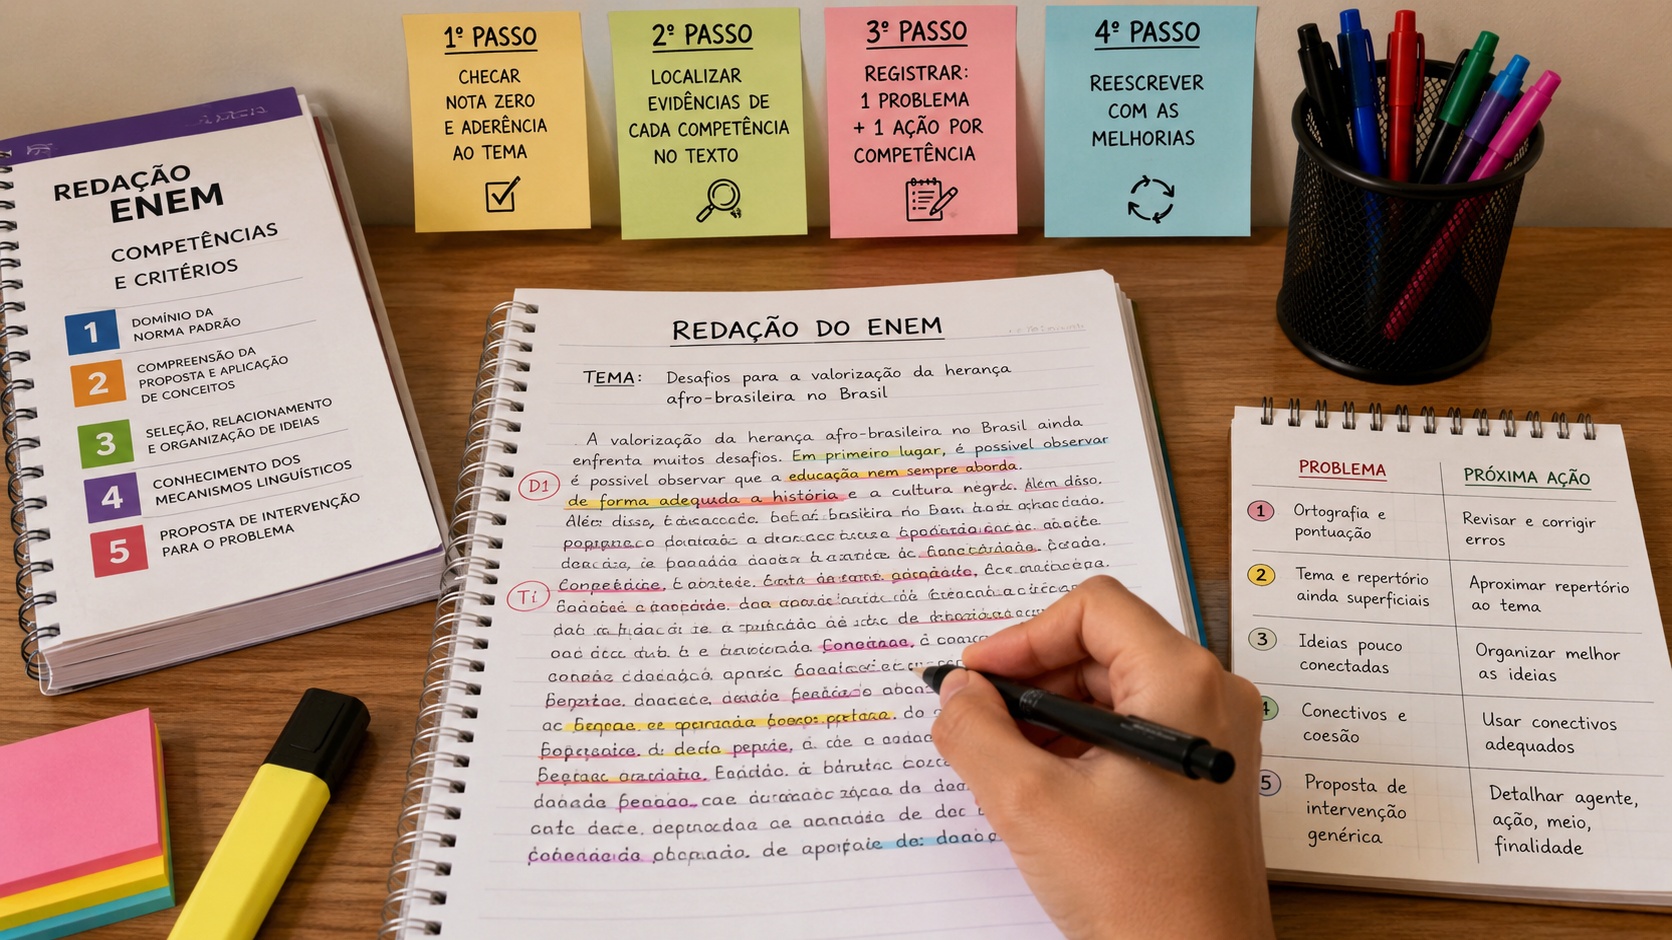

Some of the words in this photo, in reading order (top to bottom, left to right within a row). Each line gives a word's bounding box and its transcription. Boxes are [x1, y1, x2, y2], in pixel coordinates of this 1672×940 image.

[473, 26, 536, 47] PASSO
[685, 24, 752, 45] PASSO
[899, 20, 967, 42] PASSO
[1130, 20, 1200, 43] PASSO
[459, 69, 520, 84] CHECAR
[652, 68, 742, 85] LOCALIZAR
[865, 65, 968, 82] REGISTRAR:
[1090, 74, 1204, 91] REESCREVER
[447, 95, 487, 109] NOTA
[494, 94, 535, 108] ZERO
[649, 91, 740, 111] EVIDÊNCIAS
[749, 94, 769, 109] DE
[861, 92, 870, 109] 1
[879, 92, 969, 109] PROBLEMA
[1109, 103, 1147, 119] COM
[1157, 103, 1178, 118] AS
[445, 121, 453, 135] E
[462, 115, 547, 134] ADERÊNCIA
[629, 123, 670, 138] CADA
[678, 116, 789, 137] COMPETÊNCIA
[875, 119, 883, 135] 1
[893, 115, 939, 139] AÇÃO
[950, 118, 983, 134] POR
[1092, 130, 1195, 146] MELHORIAS
[453, 146, 474, 160] AO
[482, 144, 527, 159] TEMA
[655, 149, 677, 164] NO
[685, 148, 738, 163] TEXTO
[854, 142, 976, 163] COMPETÊNCIA
[54, 164, 190, 201] REDAÇÃO
[110, 183, 224, 224] ENEM
[111, 223, 278, 262] COMPETÊNCIAS
[115, 276, 126, 289] E
[135, 259, 238, 286] CRITÉRIOS
[132, 311, 191, 327] DOMÍNIO
[196, 308, 213, 318] DA
[85, 322, 97, 342] 1
[134, 327, 184, 342] NORMA
[189, 316, 240, 334] PADRÃO
[672, 315, 799, 343] REDAÇÃO
[816, 320, 850, 337] DO
[868, 317, 942, 336] ENEM
[137, 350, 235, 374] COMPREENSÃO
[237, 344, 257, 358] DA
[139, 371, 206, 389] PROPOSTA
[208, 367, 217, 379] E
[221, 355, 288, 375] APLICAÇÃO
[583, 370, 641, 387] TEMA:
[667, 370, 730, 387] Desafios
[743, 374, 778, 387] para
[812, 367, 901, 381] valorização
[914, 365, 934, 377] da
[945, 364, 1011, 377] herança
[89, 372, 108, 395] 2
[141, 393, 158, 403] DE
[162, 380, 236, 400] CONCEITOS
[667, 390, 795, 409] afro-brasileira
[807, 390, 828, 402] no
[840, 386, 887, 400] Brasil
[146, 420, 209, 440] SELEÇÃO,
[213, 398, 332, 428] RELACIONAMENTO
[148, 444, 156, 454] E
[160, 427, 255, 452] ORGANIZAÇÃO
[259, 424, 276, 435] DE
[280, 416, 319, 431] IDEIAS
[587, 432, 597, 445] A
[611, 433, 701, 448] valorização
[715, 432, 736, 444] da
[749, 431, 814, 444] herança
[826, 426, 942, 444] afro-brasileira
[953, 425, 971, 436] no
[981, 419, 1027, 433] Brasil
[1038, 416, 1083, 429] ainda
[97, 433, 115, 455] 3
[573, 453, 642, 470] enfrenta
[653, 454, 704, 466] muitos
[715, 450, 782, 467] desafios.
[793, 448, 816, 462] Em
[826, 448, 890, 463] primeiro
[900, 446, 946, 460] lugar,
[956, 442, 966, 454] é
[1044, 434, 1109, 449] observar
[153, 462, 267, 490] CONHECIMENTO
[272, 455, 300, 468] DOS
[789, 466, 859, 482] educação
[1300, 460, 1386, 476] PROBLEMA
[1464, 465, 1538, 483] PRÓXIMA
[1547, 469, 1590, 487] AÇÃO
[155, 479, 252, 506] MECANISMOS
[256, 459, 352, 487] LINGUÍSTICOS
[529, 479, 549, 493] D1
[102, 486, 123, 508] 4
[160, 519, 235, 541] PROPOSTA
[240, 514, 257, 526] DE
[262, 493, 360, 521] INTERVENÇÃO
[1256, 505, 1266, 517] 1
[1294, 503, 1369, 522] Ortografia
[1377, 509, 1386, 521] e
[1463, 511, 1516, 525] Revisar
[1526, 518, 1533, 526] e
[1542, 517, 1596, 533] corrigir
[163, 542, 199, 557] PARA
[203, 536, 216, 550] O
[219, 524, 295, 546] PROBLEMA
[1295, 525, 1371, 541] pontuação
[1466, 536, 1505, 546] erros
[111, 539, 129, 563] 5
[1255, 568, 1267, 582] 2
[1296, 567, 1334, 580] Tema
[1341, 572, 1351, 583] e
[1358, 572, 1428, 588] repertório
[1470, 575, 1546, 594] Aproximar
[1555, 581, 1629, 597] repertório
[1297, 589, 1338, 602] ainda
[1348, 591, 1429, 609] superficiais
[1471, 600, 1491, 612] ao
[1500, 599, 1541, 612] tema
[1257, 632, 1267, 646] 3
[1299, 633, 1347, 649] Ideias
[1359, 642, 1402, 656] pouco
[1476, 642, 1555, 663] Organizar
[1566, 646, 1620, 660] melhor
[1300, 659, 1389, 674] conectadas
[1479, 670, 1497, 680] as
[1509, 666, 1556, 682] ideias
[1302, 703, 1387, 721] Conectivos
[1397, 711, 1407, 723] e
[1483, 712, 1521, 727] Usar
[1532, 716, 1617, 731] conectivos
[1304, 729, 1359, 743] coesão
[1486, 736, 1574, 757] adequados
[1262, 776, 1271, 790] 5
[1305, 774, 1377, 796] Proposta
[1387, 778, 1407, 794] de
[1490, 785, 1564, 802] Detalhar
[1575, 790, 1638, 810] agente,
[1307, 801, 1406, 822] intervenção
[1493, 812, 1537, 830] ação,
[1547, 815, 1591, 832] meio,
[1308, 827, 1383, 847] genérica
[1495, 835, 1583, 856] finalidade
